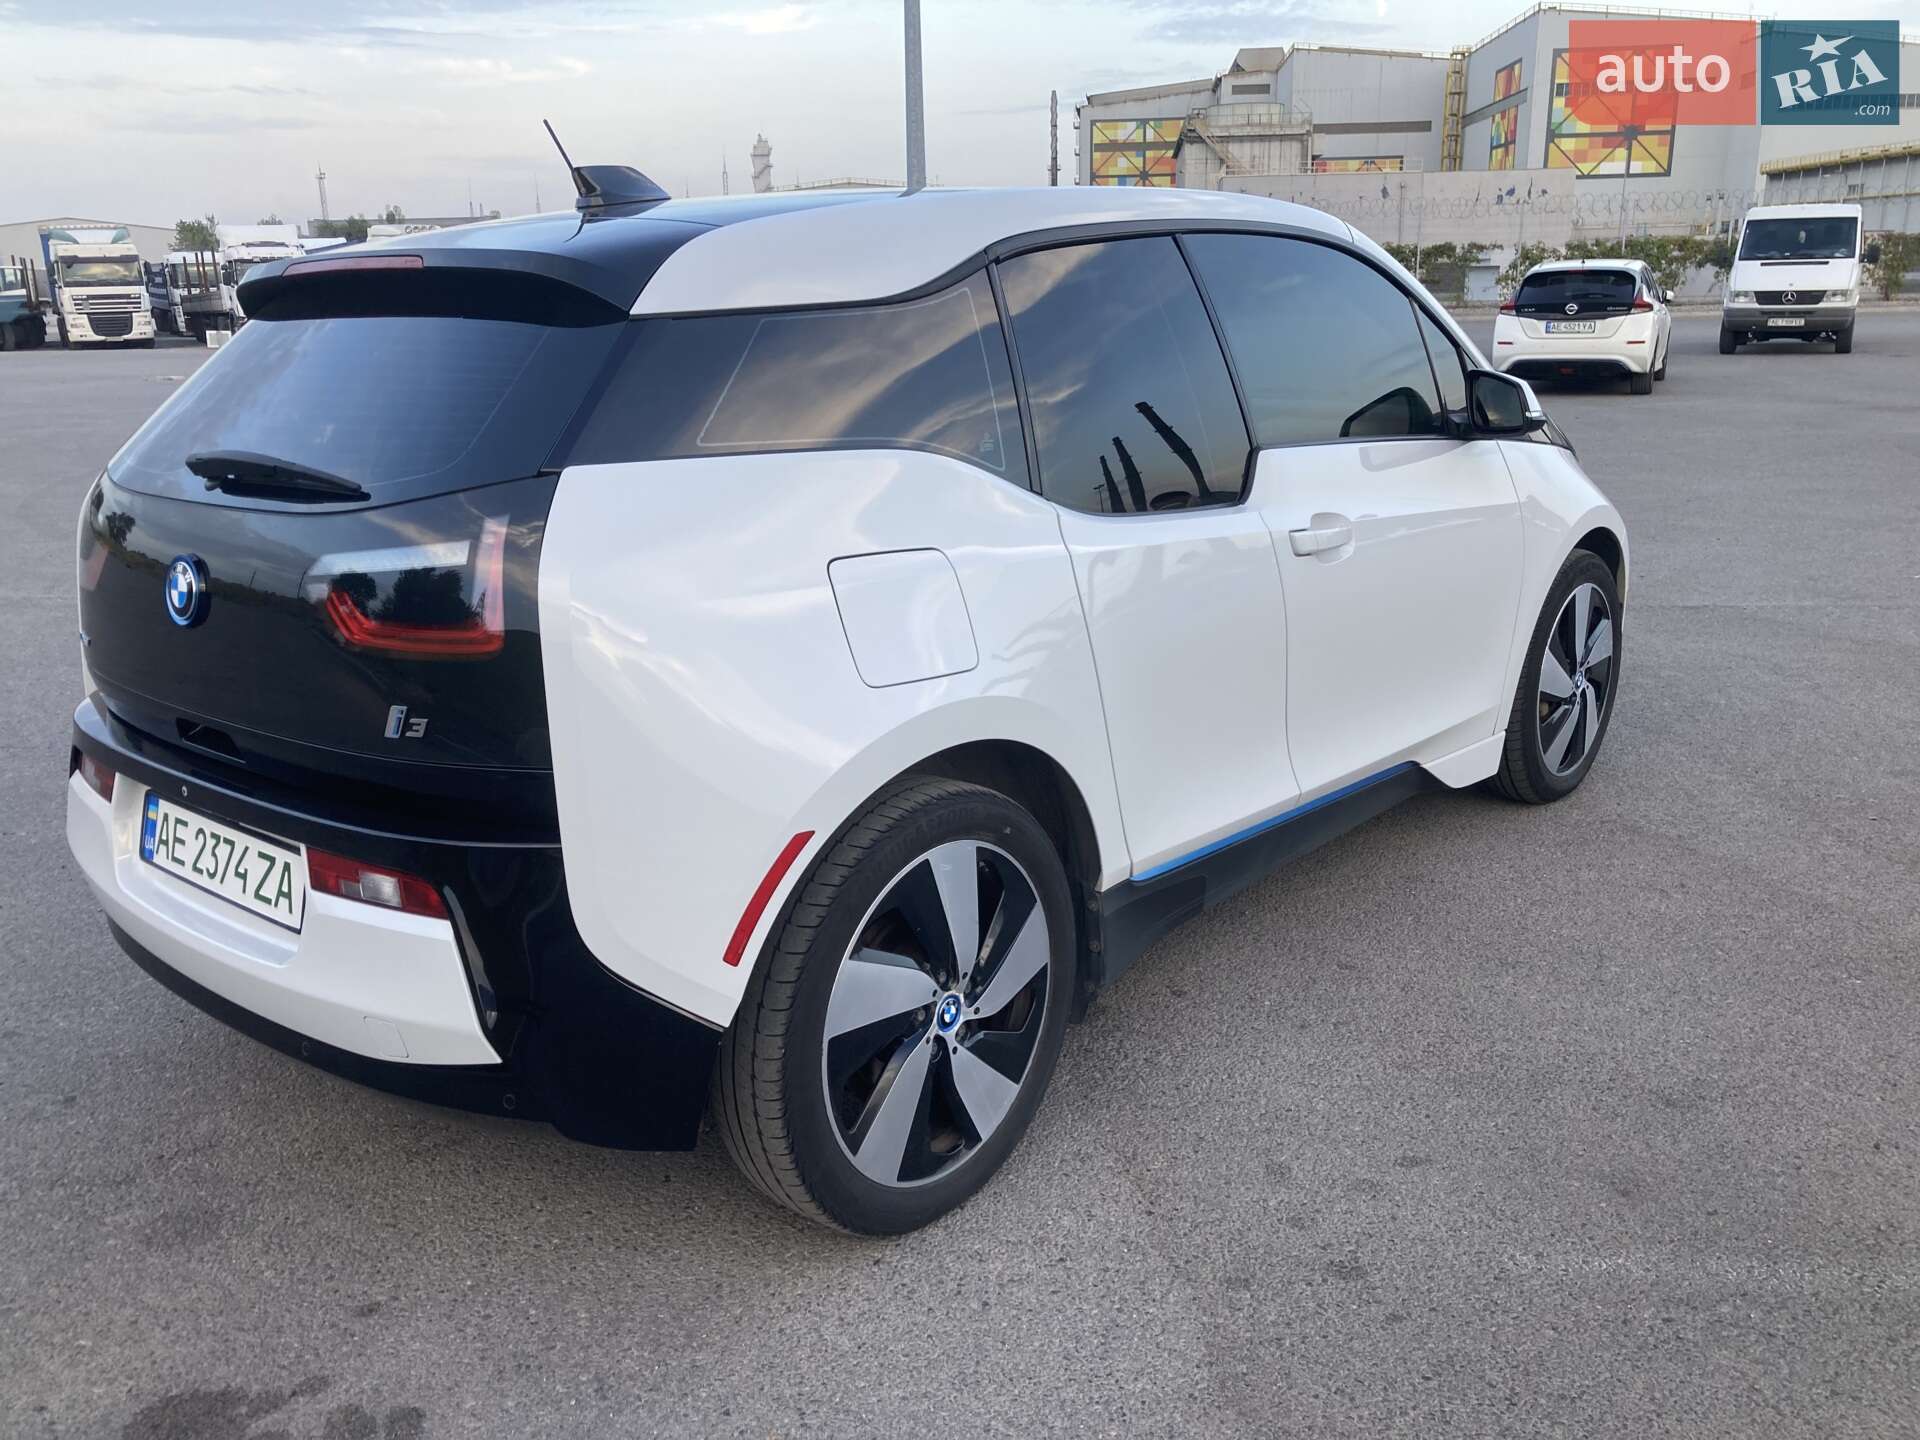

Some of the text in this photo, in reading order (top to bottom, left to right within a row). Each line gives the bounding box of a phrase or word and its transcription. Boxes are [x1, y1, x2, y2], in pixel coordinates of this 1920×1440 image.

[384, 705, 429, 738] i3
[145, 834, 154, 852] UA
[156, 812, 293, 914] AE 2374 ZA
